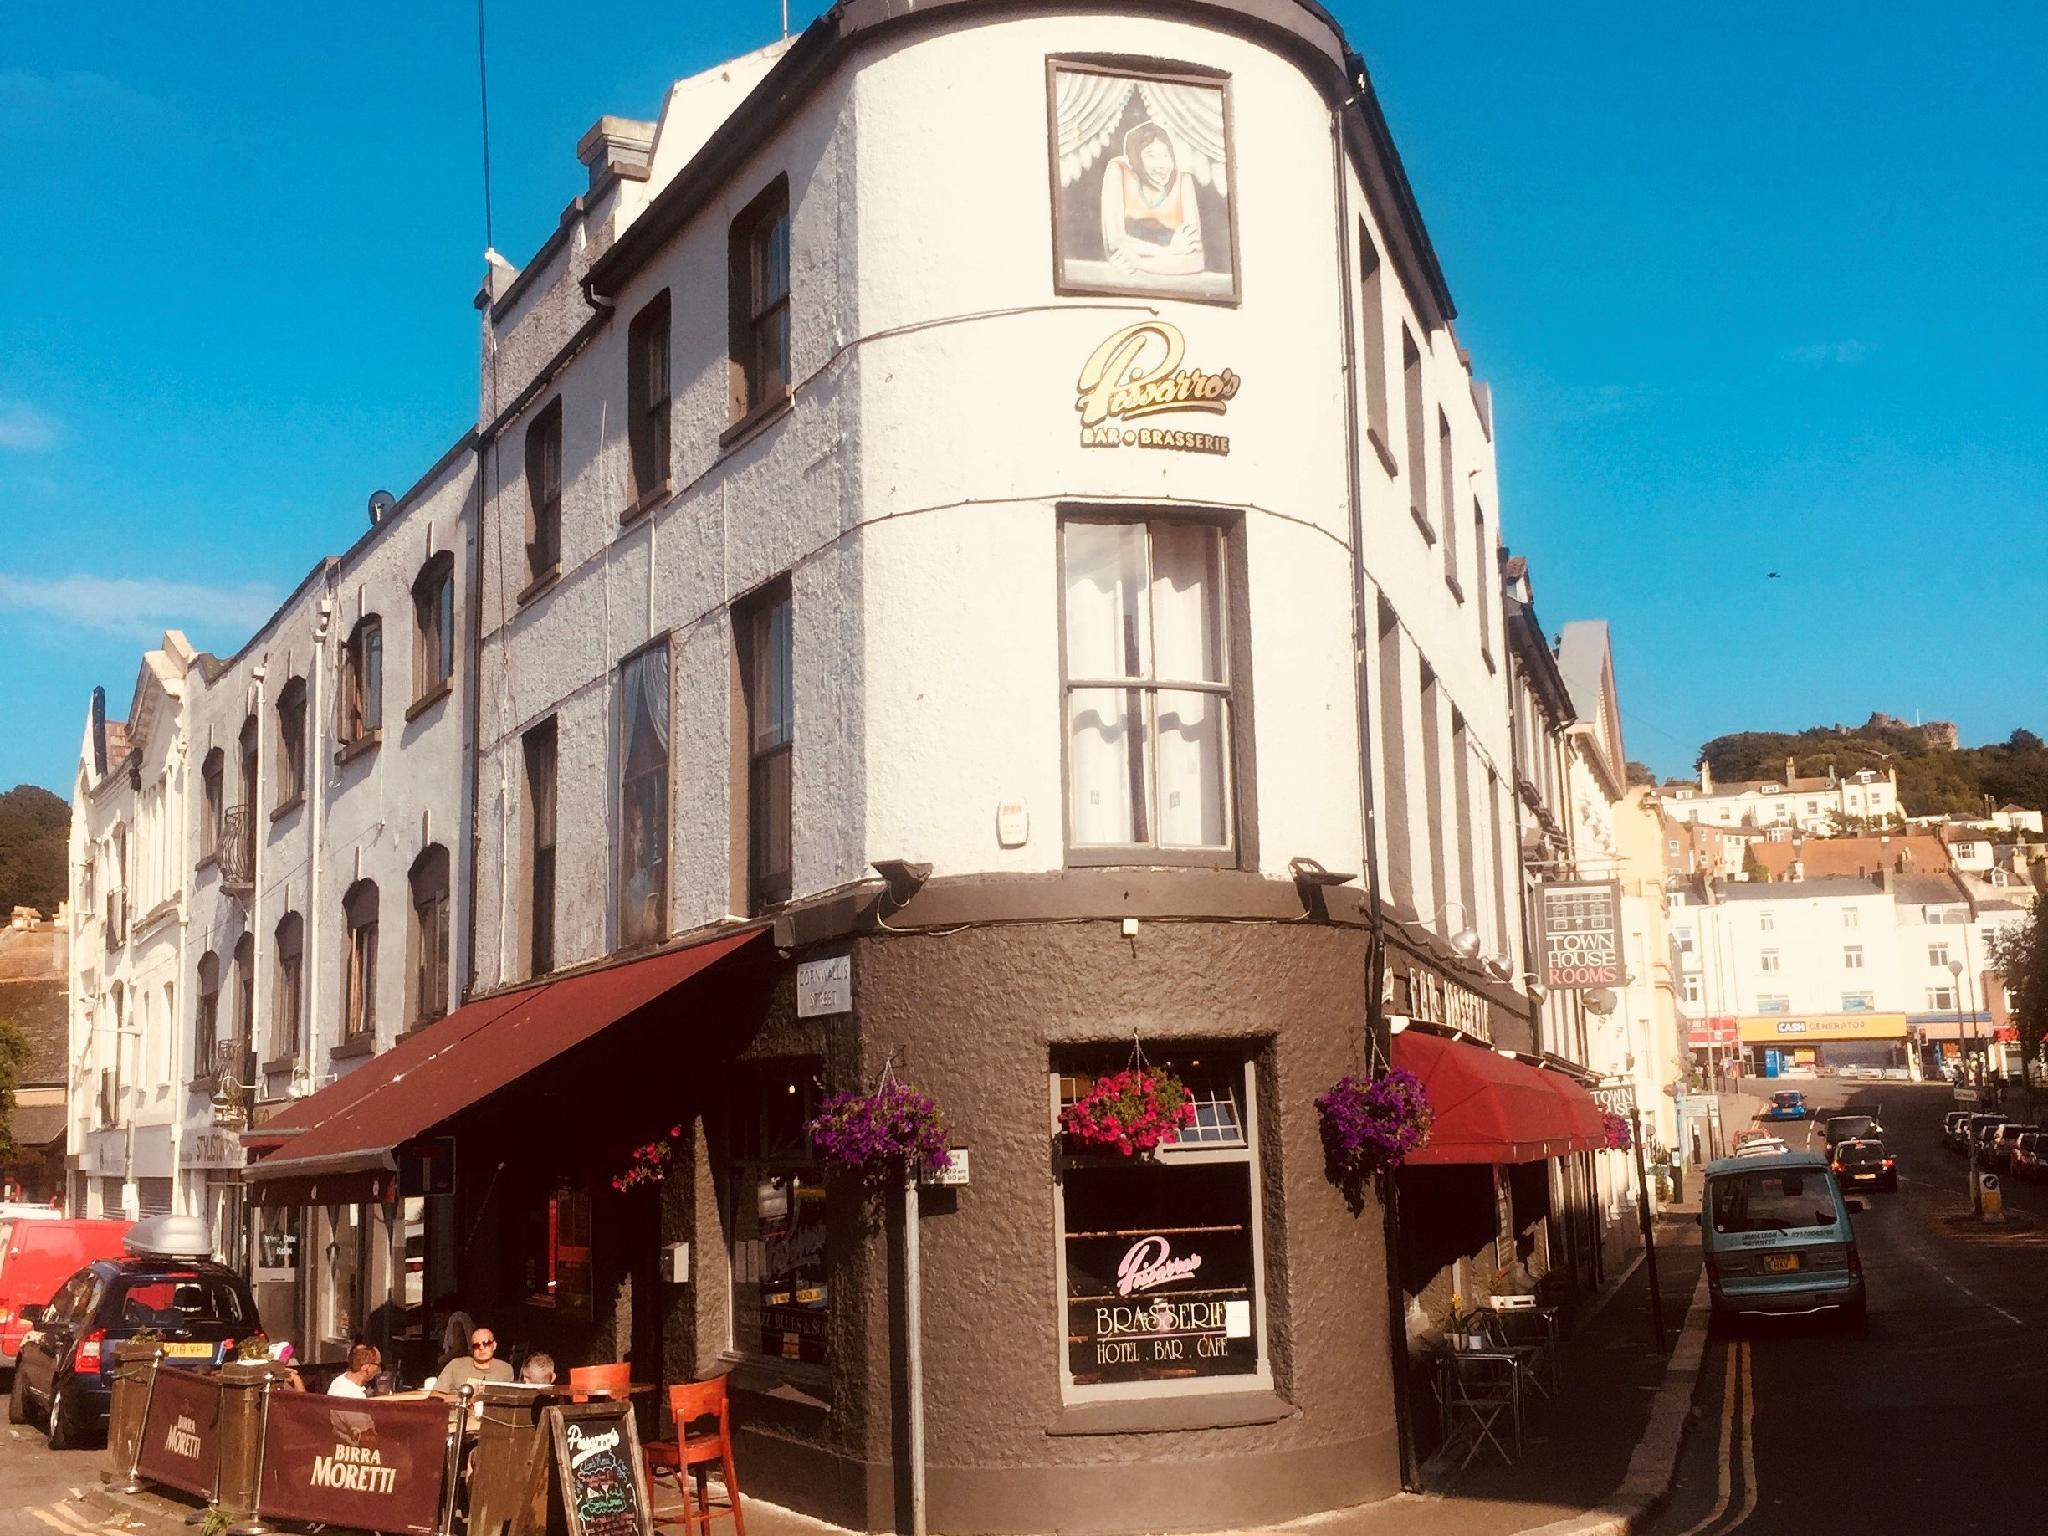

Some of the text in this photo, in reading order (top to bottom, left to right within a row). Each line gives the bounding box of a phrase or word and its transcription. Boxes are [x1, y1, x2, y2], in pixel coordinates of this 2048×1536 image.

[1081, 427, 1230, 457] BAR BRASSERIE
[1546, 932, 1615, 951] TOWN
[1548, 950, 1617, 968] HOUSE
[1549, 966, 1617, 986] ROOMS
[809, 990, 837, 1008] STREET
[1778, 1023, 1805, 1033] CASH
[1590, 1087, 1633, 1105] TOWN
[1096, 1302, 1226, 1334] BRASSERIE
[1097, 1342, 1140, 1365] HOTEL
[1154, 1338, 1184, 1360] BAR
[177, 1415, 196, 1433] BIRRA
[164, 1424, 201, 1461] MORETTI
[334, 1444, 381, 1465] BIRRA
[310, 1455, 397, 1494] MORETTI
